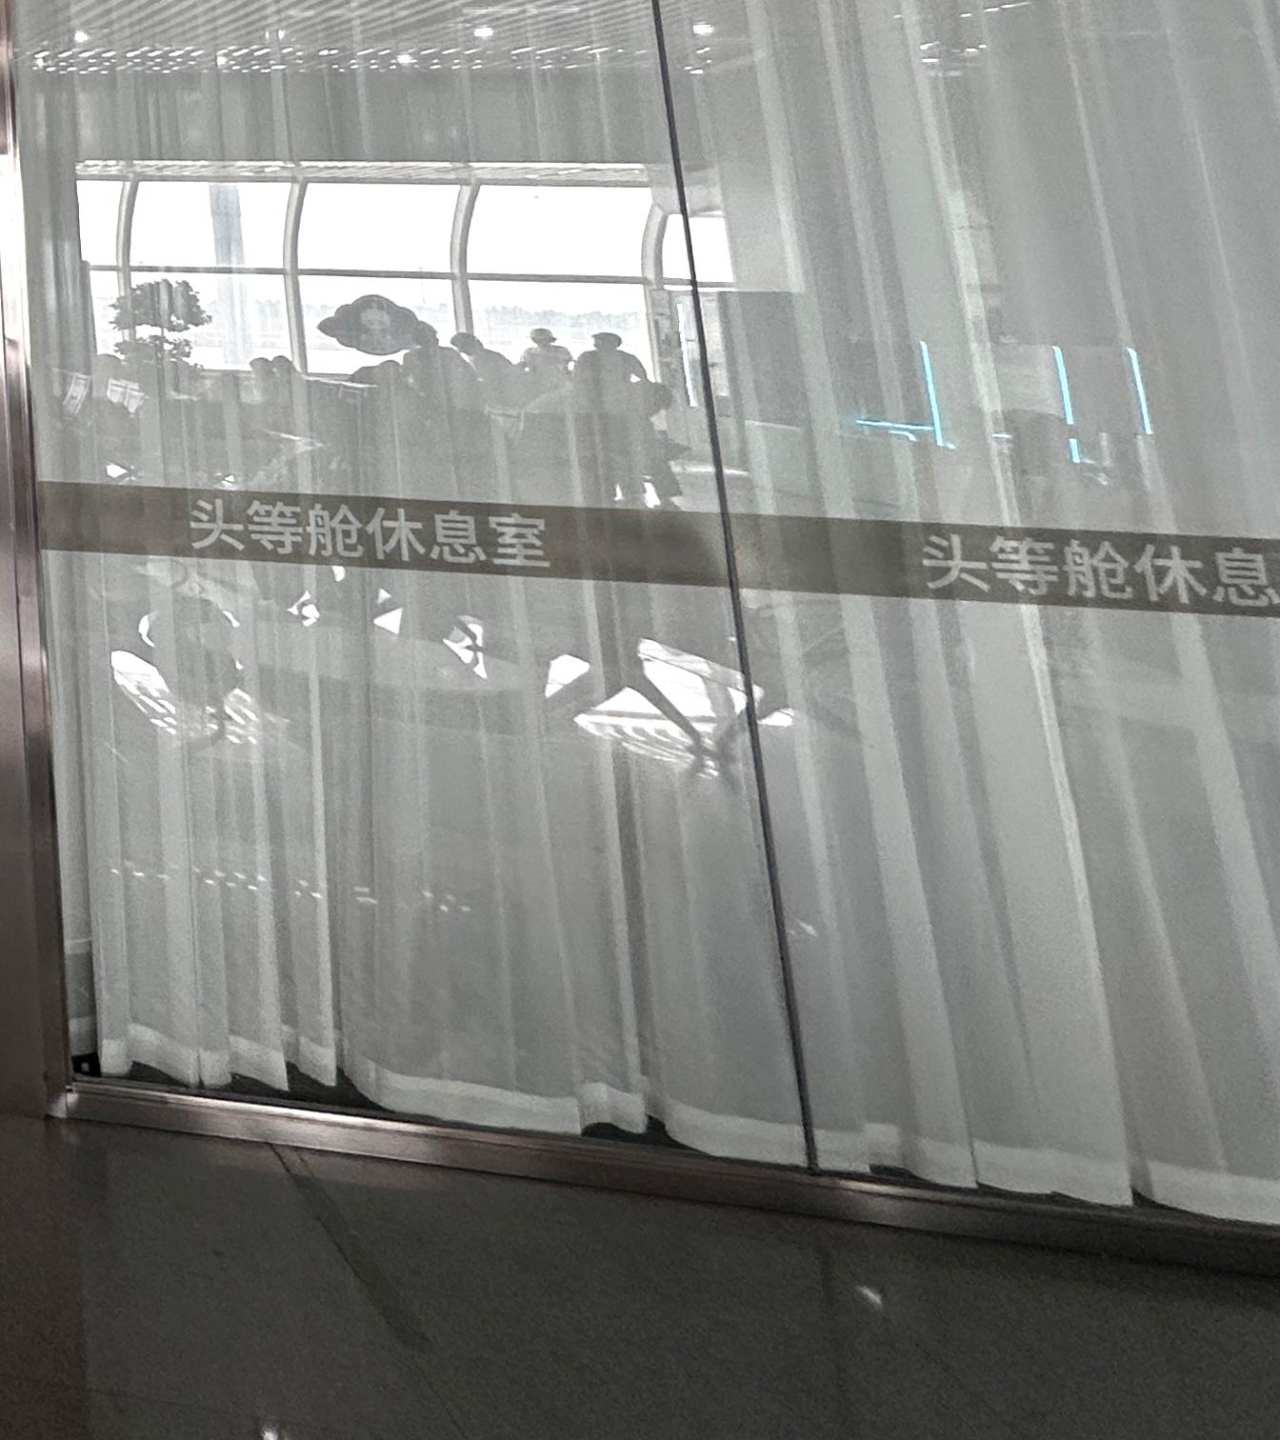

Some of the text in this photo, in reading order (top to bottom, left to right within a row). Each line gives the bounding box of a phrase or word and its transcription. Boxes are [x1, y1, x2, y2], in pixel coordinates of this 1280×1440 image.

[187, 497, 552, 571] 头等舱休息室
[921, 533, 1280, 609] 头等舱休息
